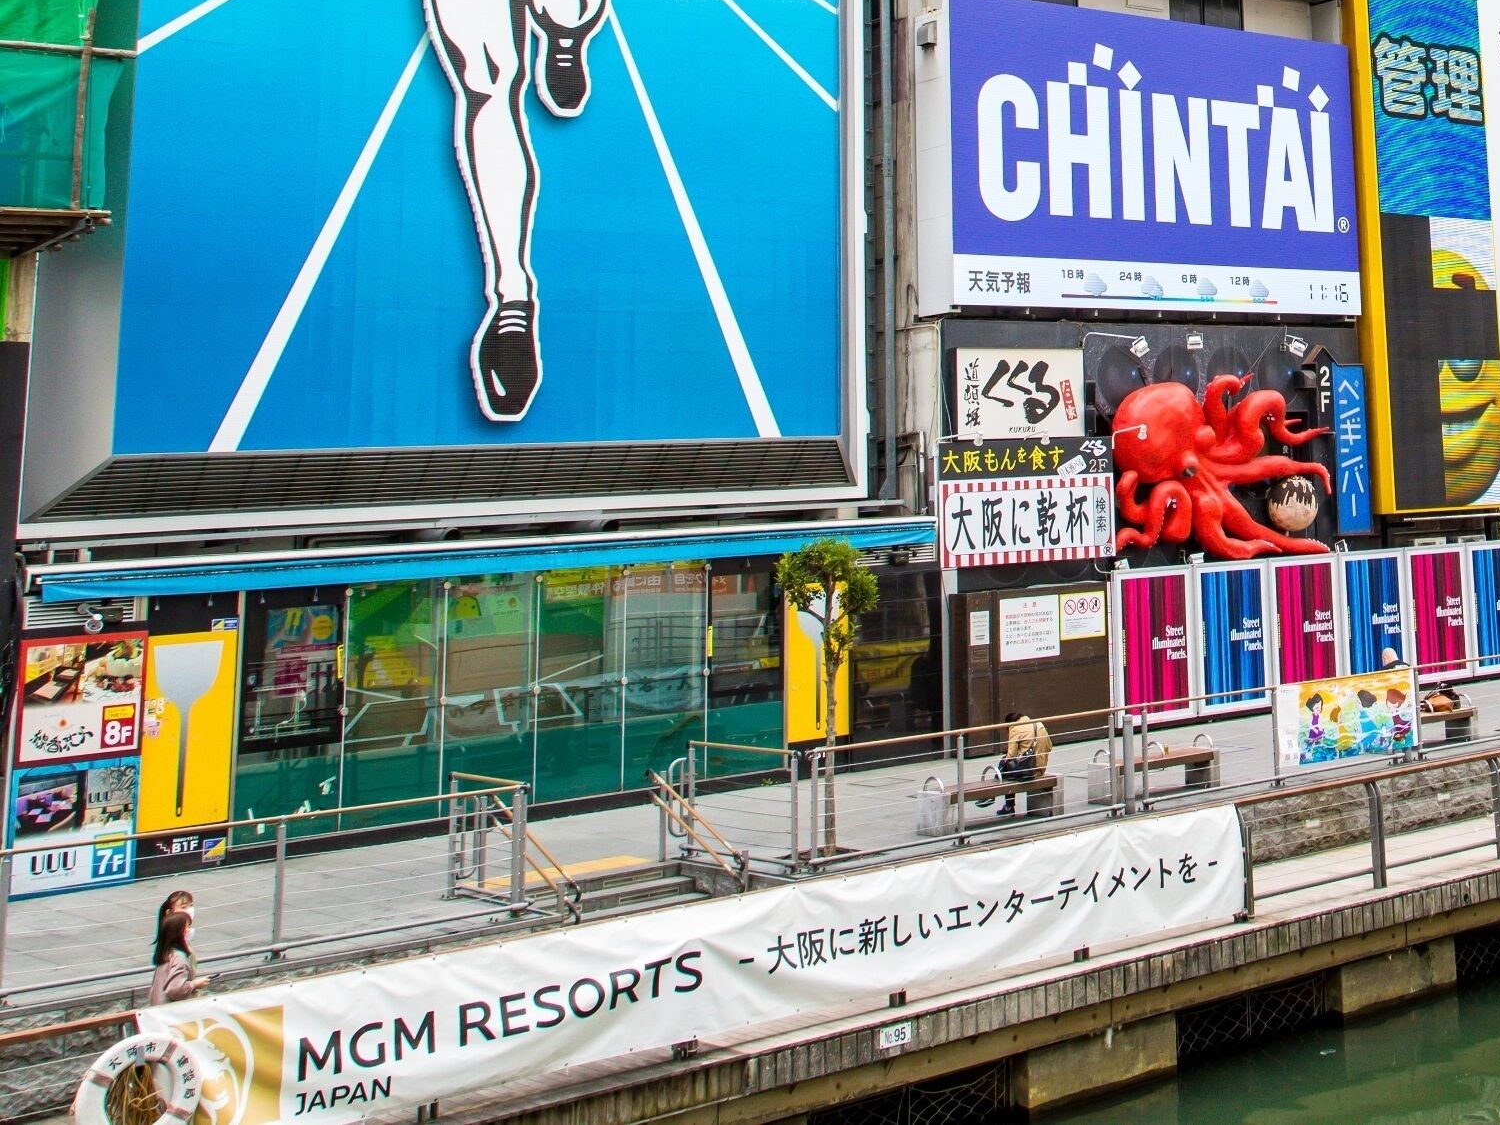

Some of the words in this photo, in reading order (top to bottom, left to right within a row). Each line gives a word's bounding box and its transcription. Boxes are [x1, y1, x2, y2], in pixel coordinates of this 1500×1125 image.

[1373, 34, 1484, 124] 管理
[968, 270, 1031, 294] 天気予報
[1062, 268, 1084, 280] 18時
[1119, 272, 1142, 283] 24時
[1182, 274, 1197, 285] 6時
[1230, 276, 1250, 287] 12時
[1309, 283, 1349, 303] 11:16
[963, 357, 982, 428] 道頓堀
[981, 359, 1060, 424] くくる
[1319, 366, 1331, 413] 2F
[942, 446, 1065, 474] 大阪もんを食す
[1338, 379, 1364, 517] ペンギンバー
[1088, 459, 1109, 473] 2F
[951, 490, 1090, 552] 大阪に乾杯
[1095, 496, 1107, 532] 検索
[1382, 602, 1398, 613] Street
[1446, 595, 1461, 606] Street
[1242, 617, 1260, 629] Street
[1314, 609, 1331, 621] Street
[1166, 625, 1184, 637] Street
[104, 721, 132, 745] 8F
[172, 840, 199, 853] B1F
[96, 849, 125, 874] 7F
[297, 1010, 435, 1083] MGM
[459, 951, 703, 1047] RESORTS
[295, 1076, 392, 1117] JAPAN
